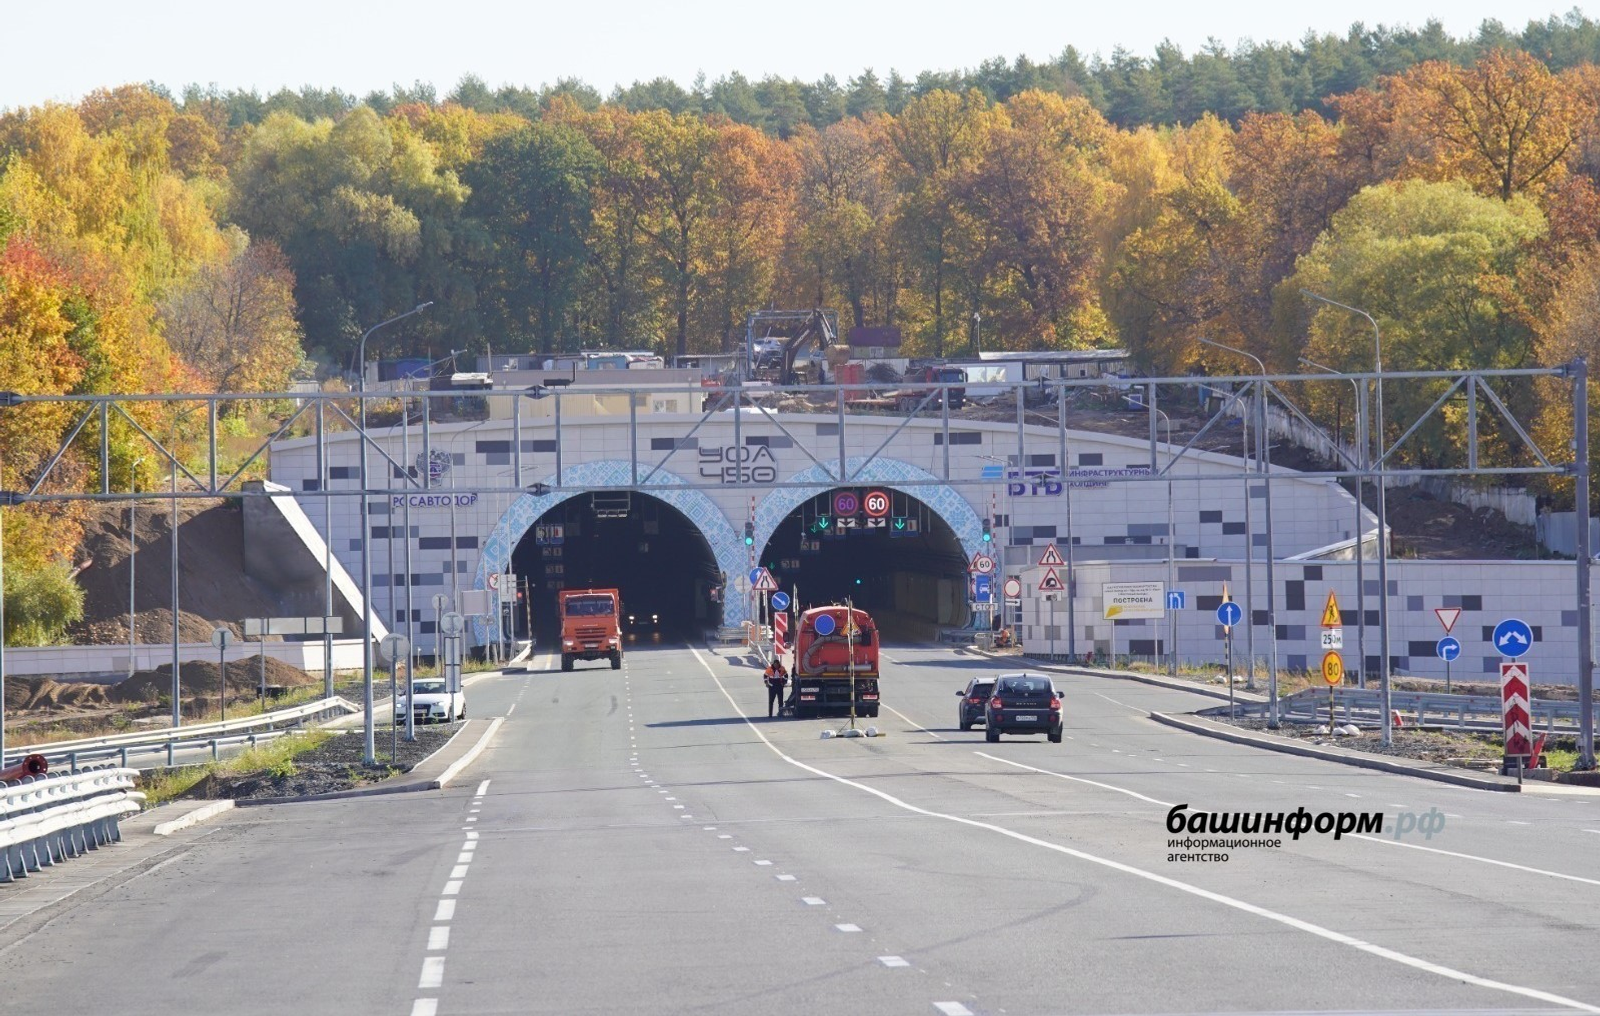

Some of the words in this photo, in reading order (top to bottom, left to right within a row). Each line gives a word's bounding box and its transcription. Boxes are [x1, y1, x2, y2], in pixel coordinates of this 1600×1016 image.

[699, 466, 776, 484] 450
[838, 498, 854, 510] 60
[868, 497, 885, 511] 60
[979, 560, 990, 569] 60
[1113, 596, 1153, 604] ПОСТРОЕНА
[1327, 662, 1339, 676] 80
